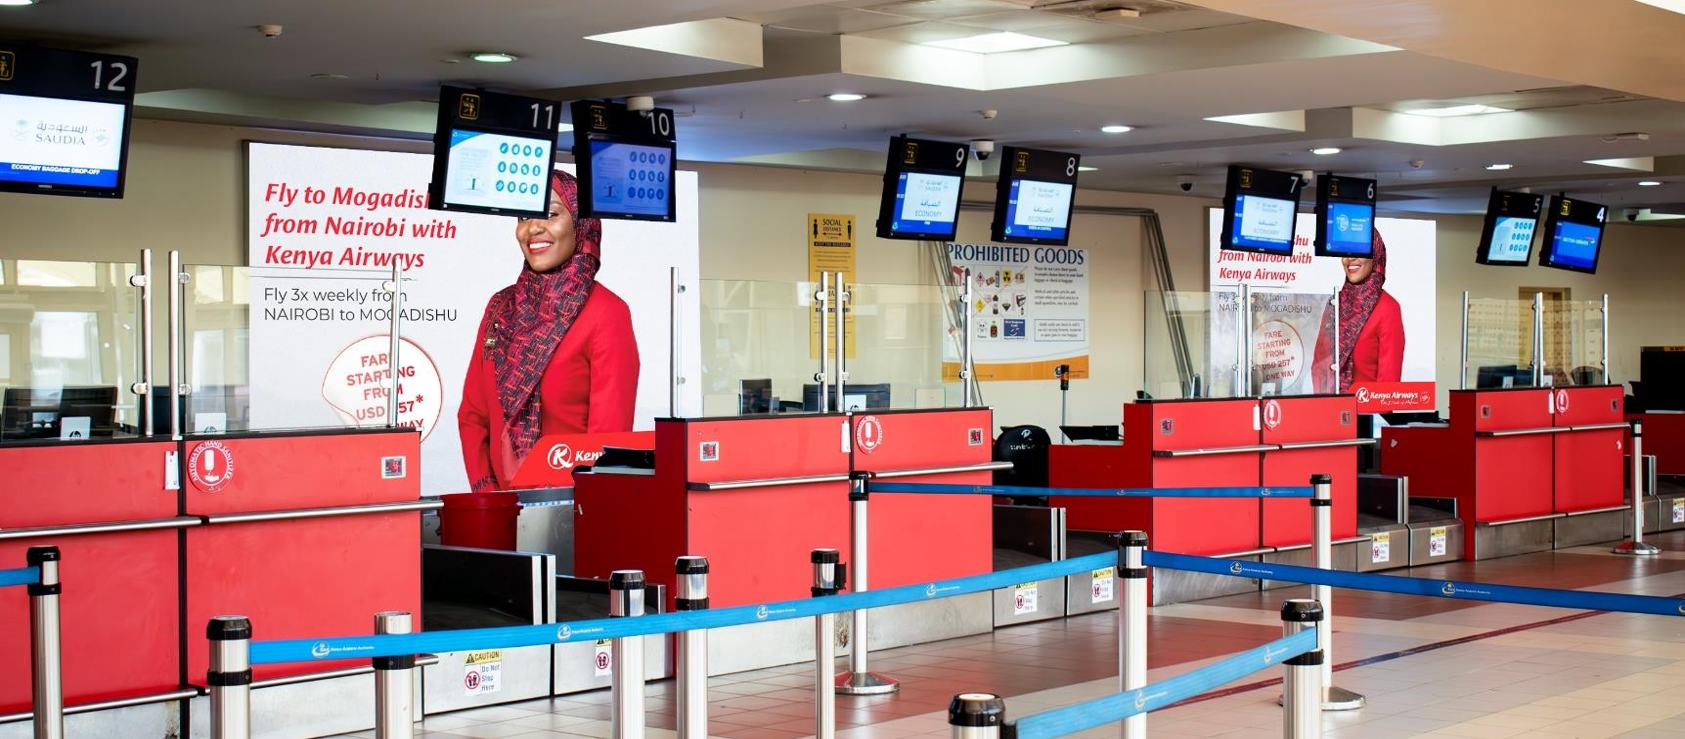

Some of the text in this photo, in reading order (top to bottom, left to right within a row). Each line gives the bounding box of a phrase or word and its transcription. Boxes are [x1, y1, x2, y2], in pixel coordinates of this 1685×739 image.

[91, 60, 128, 92] 12
[531, 103, 554, 130] 11
[648, 111, 670, 136] 10
[35, 133, 87, 146] SAUDIA
[956, 147, 964, 168] 9
[11, 163, 41, 172] ECONOMY
[41, 165, 70, 173] BAGGAGE
[1066, 157, 1075, 177] 8
[1290, 176, 1298, 194] 7
[1367, 182, 1374, 199] 6
[265, 182, 298, 207] Fly
[304, 186, 325, 205] to
[1533, 197, 1540, 213] 5
[915, 209, 942, 217] ECONOMY
[1596, 207, 1604, 222] 4
[260, 212, 457, 239] from Nairobi with
[822, 218, 842, 226] SOCIAL
[265, 245, 333, 270] Kenya
[947, 244, 1084, 265] PROHIBITED GOODS
[1217, 250, 1244, 263] from
[1289, 252, 1312, 264] with
[1220, 267, 1296, 283] Kenya Airways
[264, 287, 407, 305] Fly 3x weekly fro
[264, 307, 334, 321] NAIROBI
[340, 308, 355, 321] to
[1264, 330, 1282, 340] FARE
[1257, 338, 1291, 349] STARTING
[361, 353, 391, 367] FAR
[1265, 349, 1285, 358] FROM
[346, 366, 415, 386] STARTNG
[1266, 370, 1295, 381] ONE WAY
[1370, 391, 1391, 402] Kenya
[1391, 391, 1418, 401] Airways
[356, 394, 424, 421] USD 57
[189, 443, 205, 482] AUTOMATIC
[204, 439, 223, 449] HAND
[474, 650, 500, 662] CAUTION
[481, 664, 500, 673] Do Not
[481, 674, 494, 683] Step
[481, 684, 495, 692] Here
